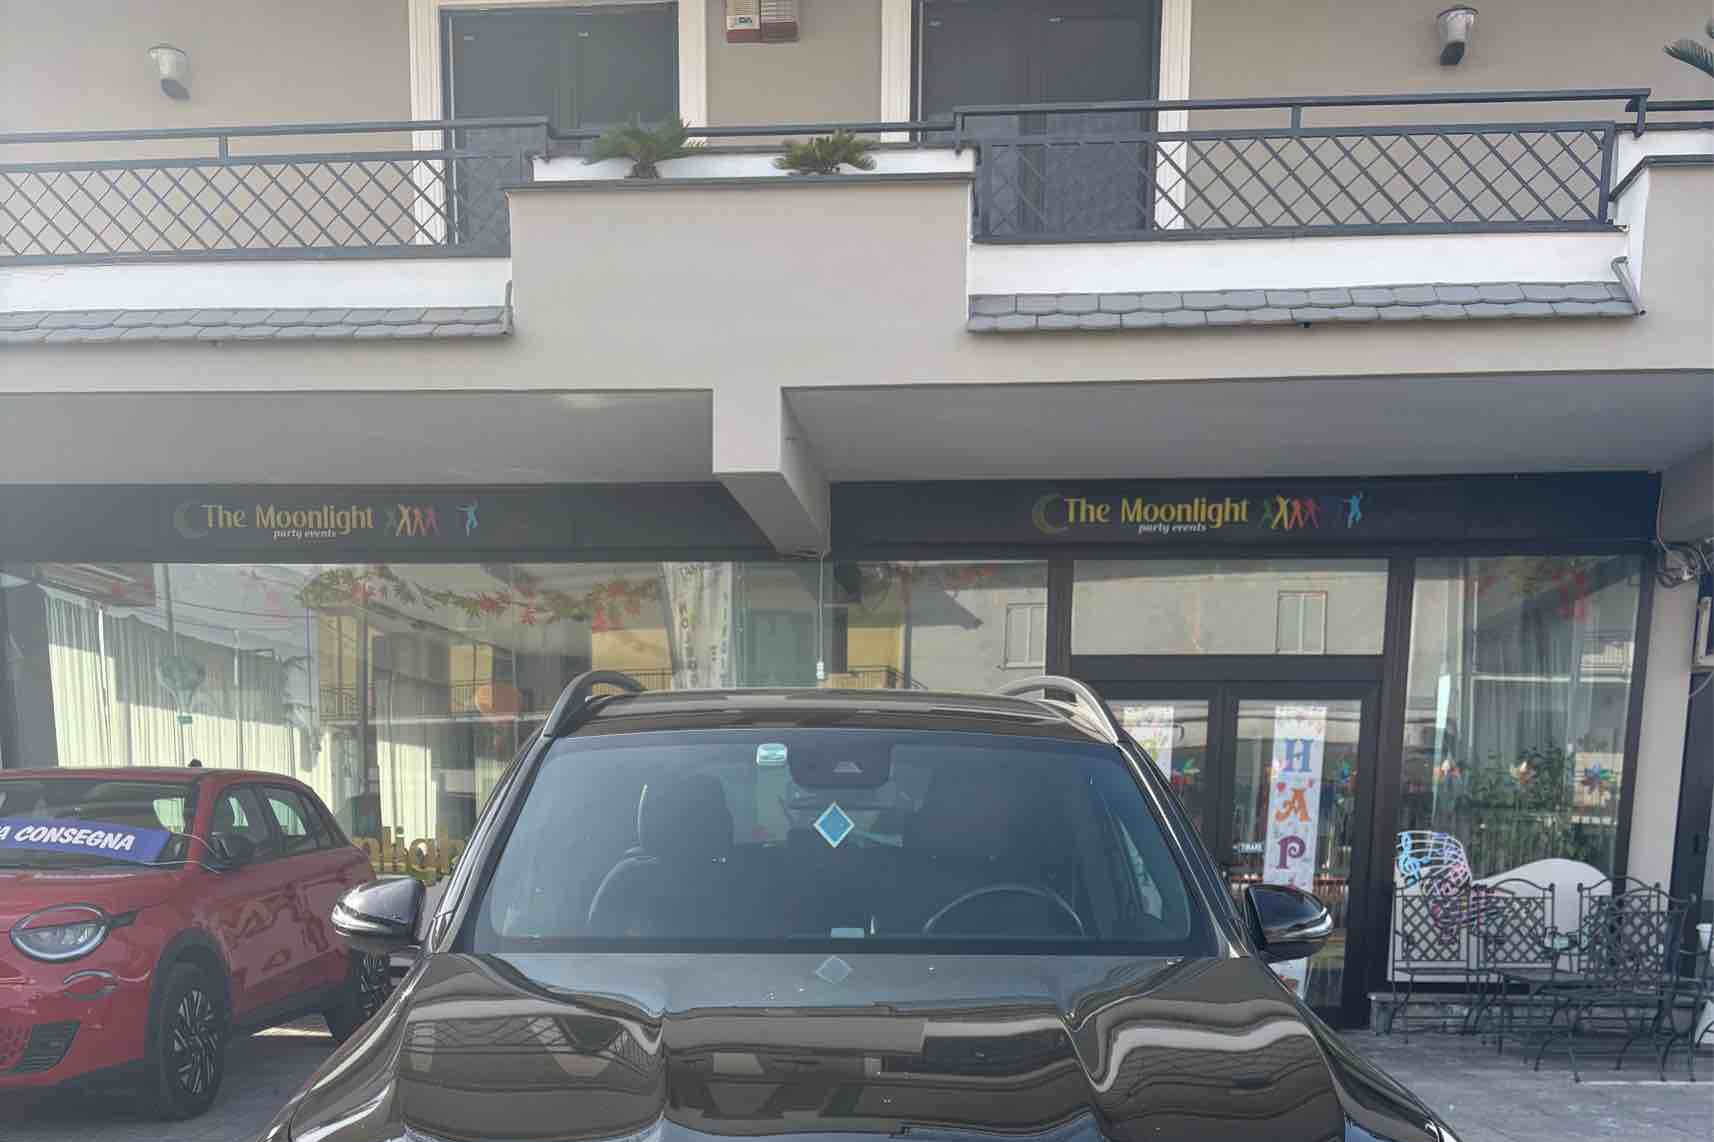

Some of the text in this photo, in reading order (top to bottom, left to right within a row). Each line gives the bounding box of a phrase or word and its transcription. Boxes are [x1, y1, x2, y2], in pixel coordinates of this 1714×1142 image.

[201, 502, 374, 534] The Moonlight
[1063, 496, 1250, 529] The Moonlight
[273, 528, 337, 541] party events
[1138, 523, 1208, 535] party events
[14, 824, 136, 851] CONSEGNA
